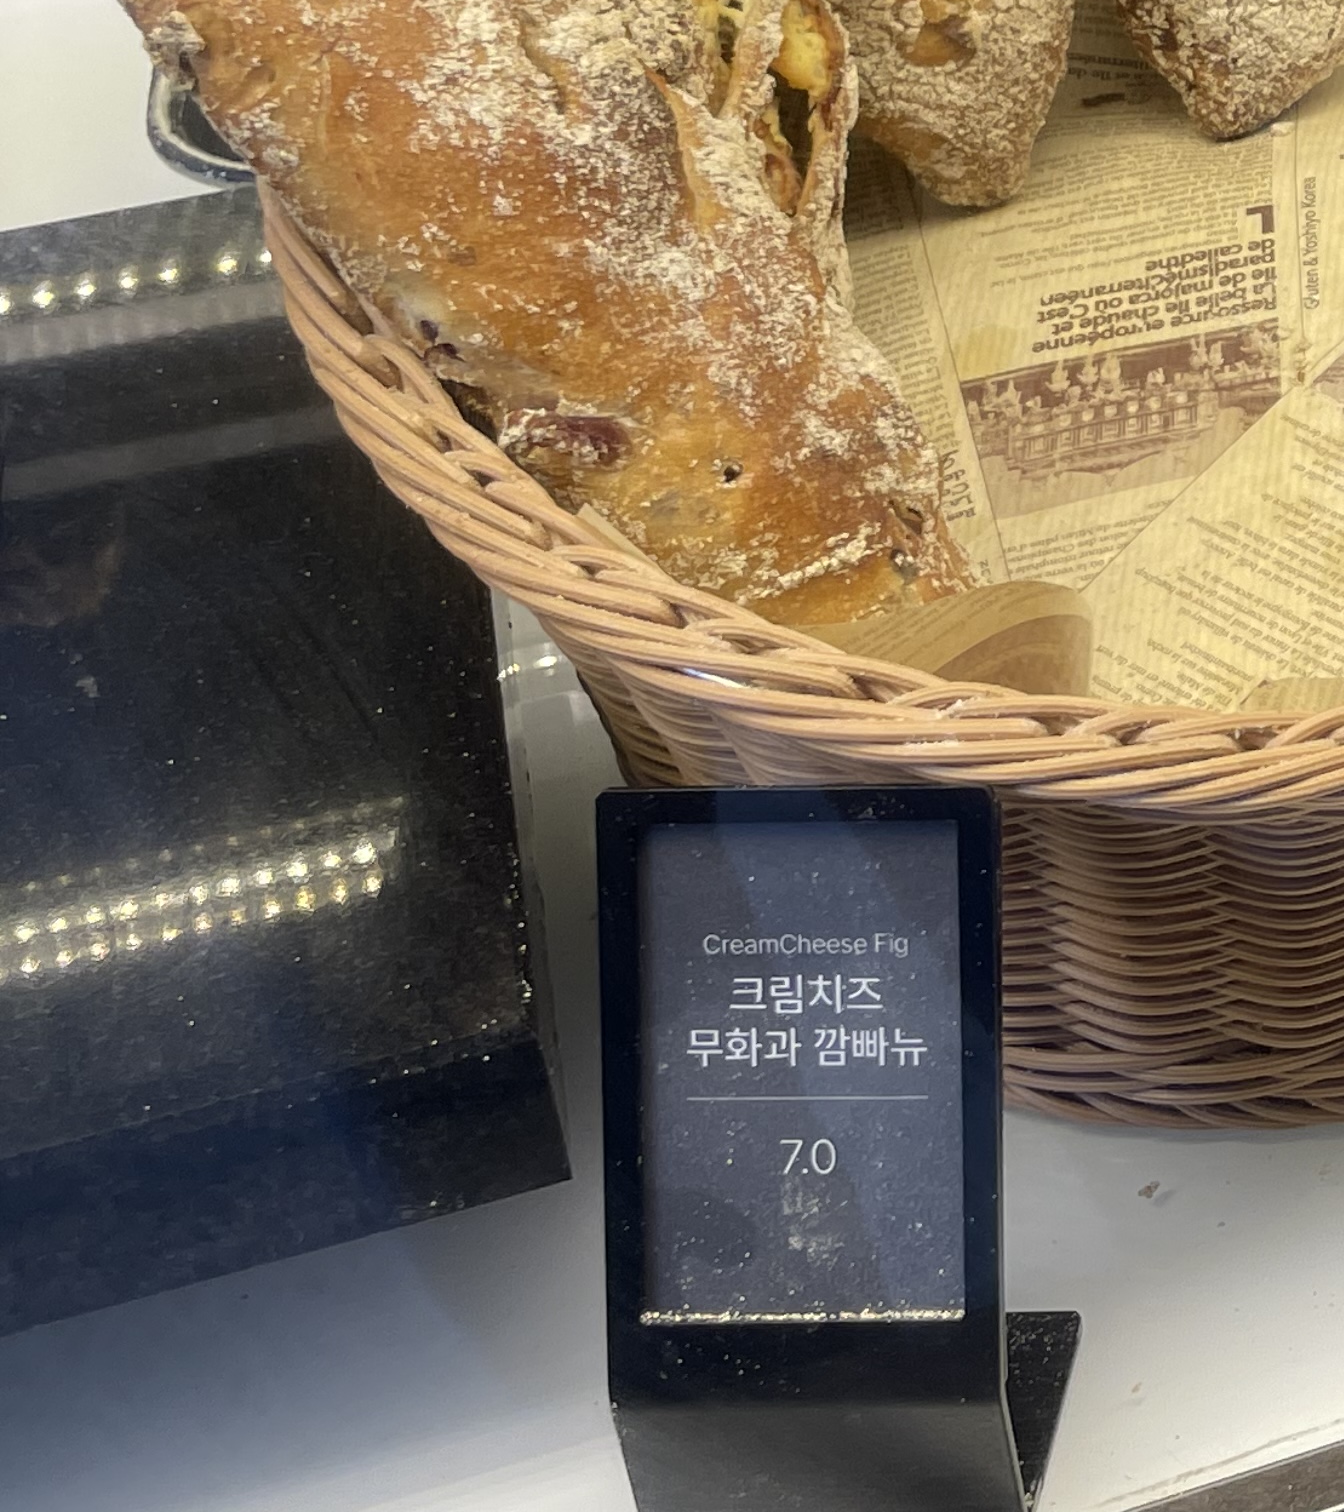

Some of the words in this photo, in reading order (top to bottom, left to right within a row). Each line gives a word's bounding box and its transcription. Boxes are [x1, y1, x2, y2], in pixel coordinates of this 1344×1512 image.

[1300, 176, 1317, 208] Korea
[1248, 236, 1275, 253] de
[1303, 256, 1319, 266] &
[1219, 272, 1246, 287] de
[1253, 282, 1276, 295] La
[1080, 306, 1159, 330] chaude
[1171, 296, 1276, 326] Ressource
[1033, 319, 1164, 352] européenne
[1052, 319, 1073, 338] et
[874, 933, 909, 959] Fig
[729, 974, 884, 1015] 크림치즈
[686, 1026, 802, 1068] 무화과
[814, 1025, 929, 1067] 깜빠뉴
[778, 1139, 837, 1175] 7.0
